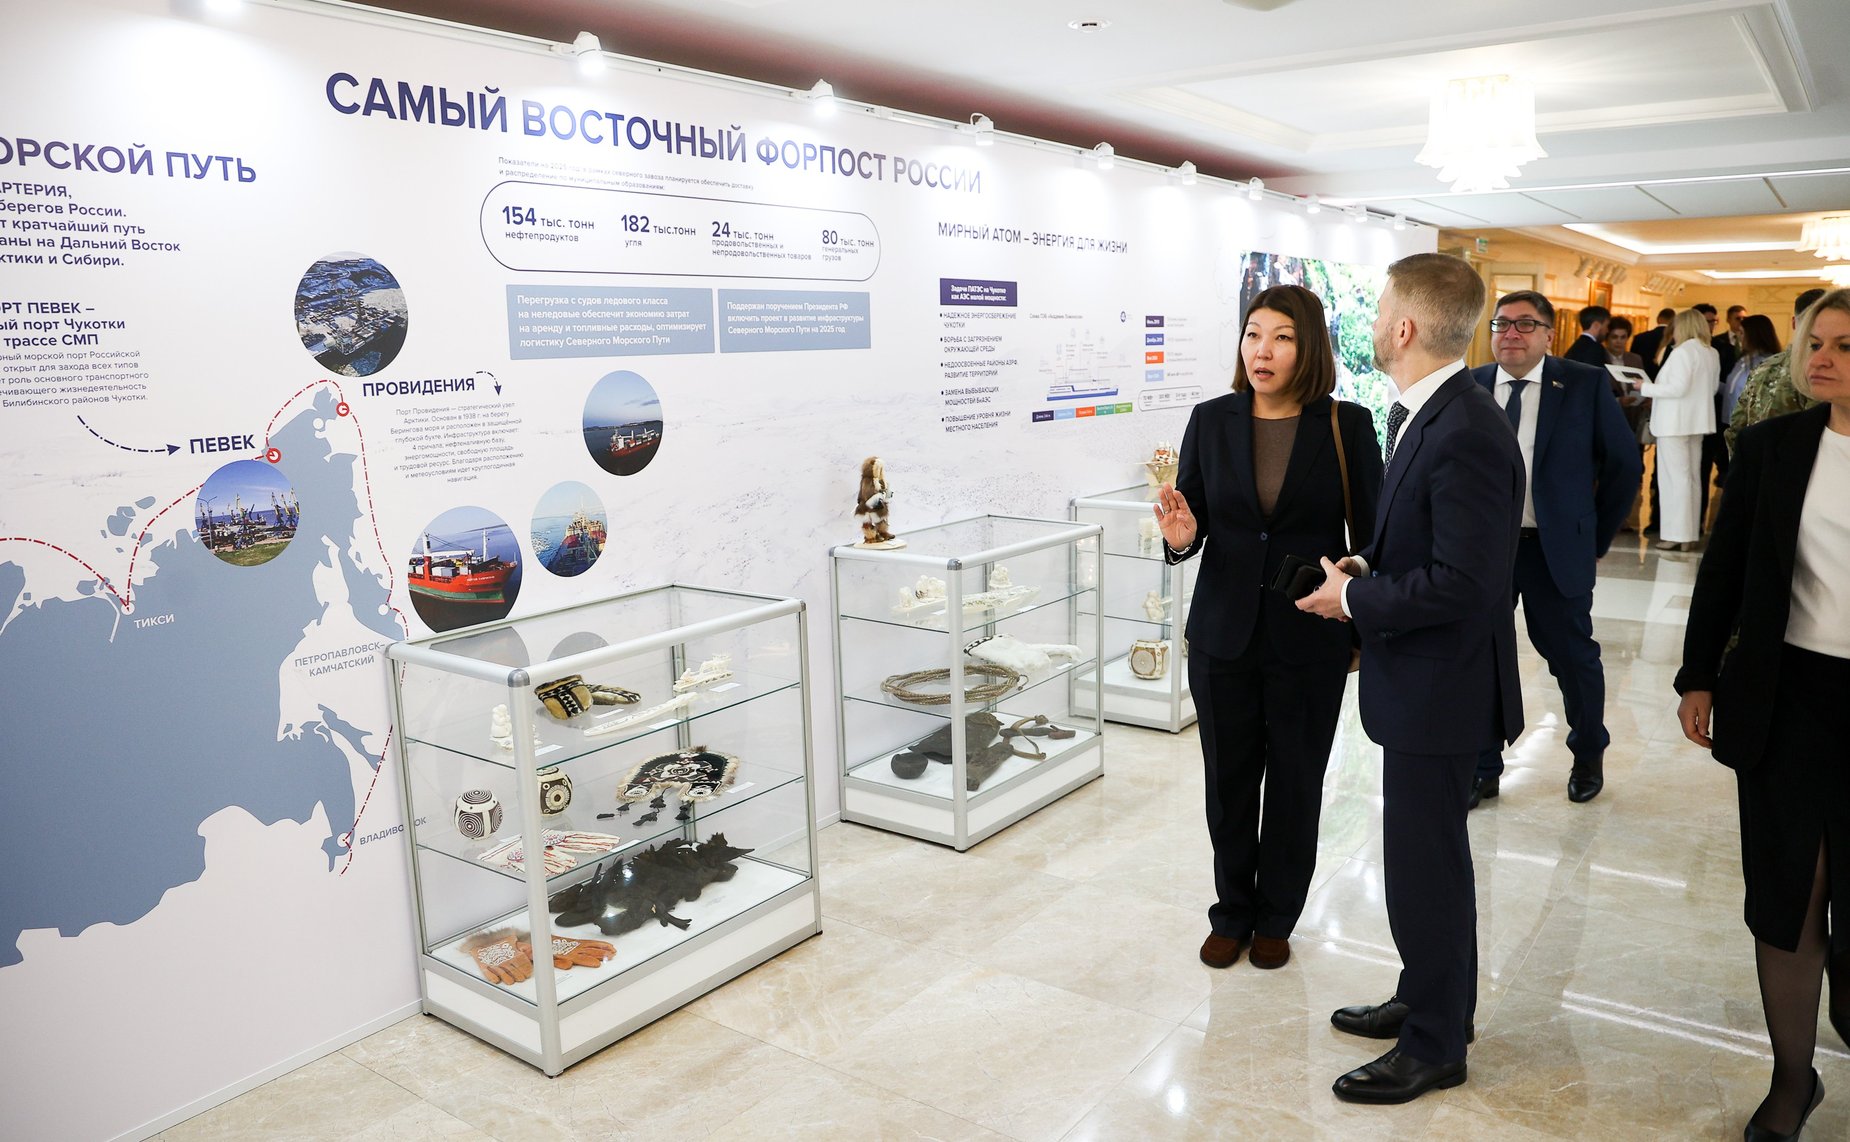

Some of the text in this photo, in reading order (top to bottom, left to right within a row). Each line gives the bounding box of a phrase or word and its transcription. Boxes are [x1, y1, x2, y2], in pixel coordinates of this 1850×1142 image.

[326, 72, 982, 194] САМЫЙ ВОСТОЧНЫЙ ФОРПОСТ РОССИИ
[166, 152, 256, 183] ПУТЬ
[0, 182, 72, 199] РТЕРИЯ,
[0, 199, 127, 217] берегов России.
[502, 206, 595, 229] 154 тыс. тонн
[621, 214, 650, 233] 182
[12, 219, 109, 233] кратчайший
[114, 224, 146, 236] путь
[712, 221, 774, 240] 24 тыс. тонн
[0, 236, 181, 252] аны на Дальний Восток
[505, 231, 579, 243] нефтепродуктов
[625, 239, 642, 248] угля
[822, 229, 838, 245] 80
[857, 239, 874, 248] тонн
[938, 222, 1128, 253] МИРНЫЙ АТОМ ЭНЕРГИЯ ДЛЯ ЖИЗНИ
[49, 255, 57, 265] и
[62, 253, 124, 268] Сибири.
[0, 302, 81, 314] РТ ПЕВЕК
[517, 295, 569, 306] Перегрузка
[577, 297, 601, 306] судов
[603, 297, 641, 306] ледового
[642, 297, 668, 305] класса
[518, 309, 690, 320] на неледовые обеспечит экономию затрат
[23, 321, 59, 333] порт
[64, 318, 125, 333] Чукотки
[519, 325, 530, 333] на
[532, 324, 563, 335] аренду
[573, 323, 618, 332] топливные
[728, 325, 764, 335] Северного
[3, 334, 99, 350] трассе СМП
[520, 335, 670, 349] логистику Северного Морского Пути
[24, 351, 64, 362] морской
[67, 352, 87, 361] порт
[90, 350, 140, 359] Российской
[3, 365, 36, 374] открыт
[39, 364, 56, 373] для
[58, 363, 89, 371] захода
[114, 361, 139, 369] типов
[8, 372, 149, 385] роль основного транспортного
[59, 383, 147, 394] жизнедеятельность
[362, 378, 475, 397] ПРОВИДЕНИЯ
[3, 397, 70, 408] Билибинского
[72, 396, 110, 405] районов
[189, 434, 256, 454] ПЕВЕК
[134, 613, 175, 629] ТИКСИ
[309, 655, 375, 677] КАМЧАТСКИЙ
[360, 817, 427, 845] ВЛАДИВООК
